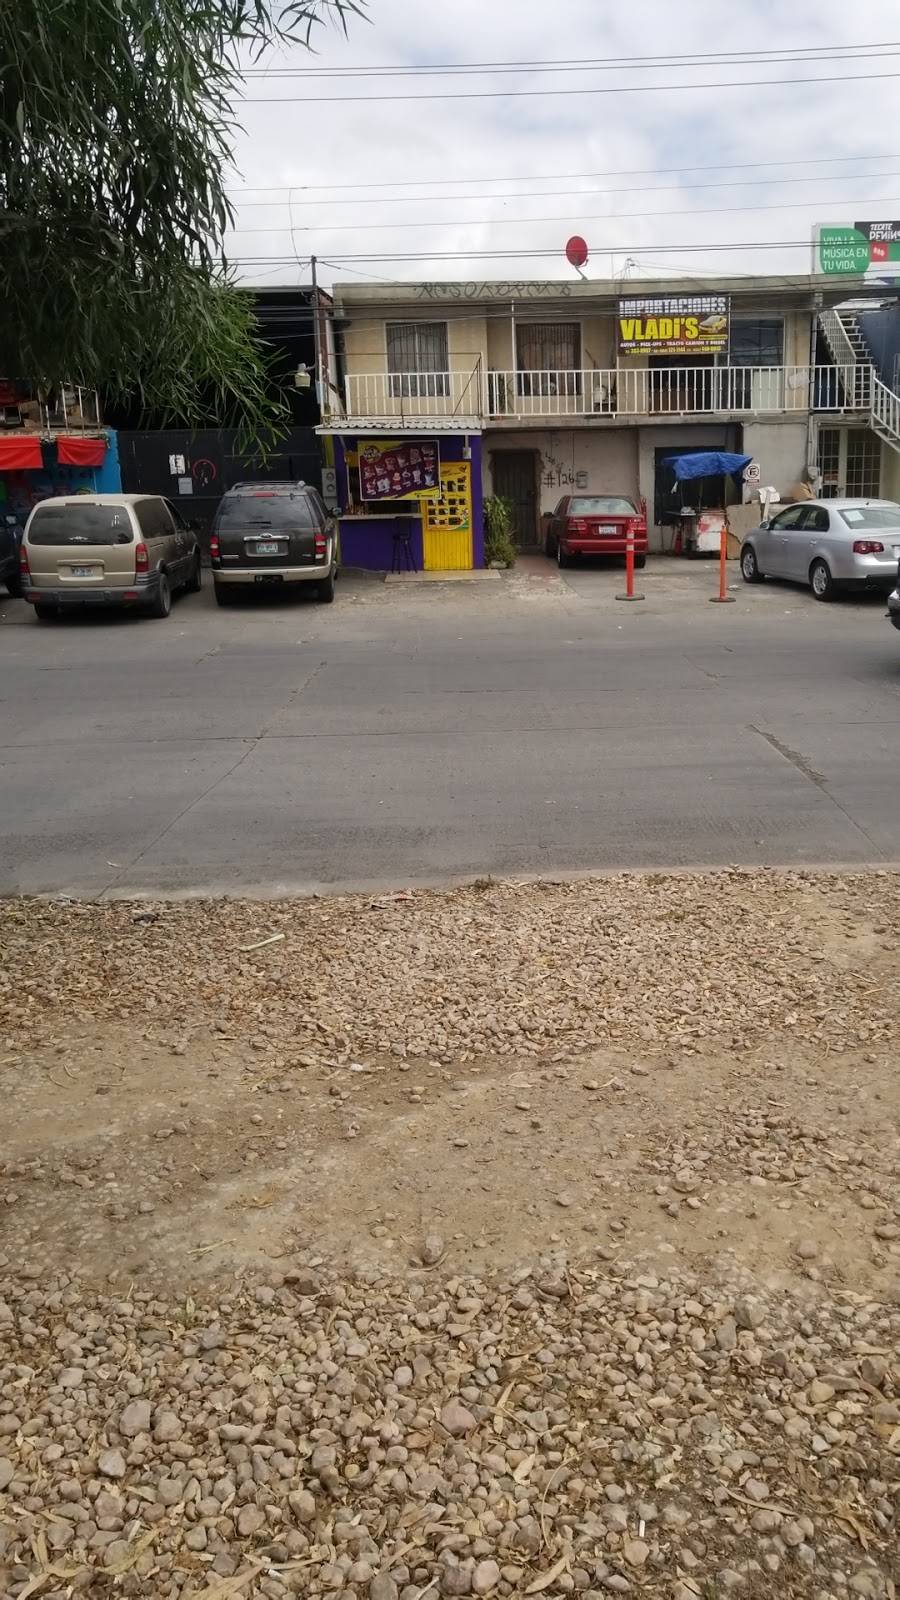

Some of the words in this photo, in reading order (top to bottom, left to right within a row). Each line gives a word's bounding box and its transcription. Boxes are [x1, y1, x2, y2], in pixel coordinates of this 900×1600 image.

[870, 223, 893, 231] TECATE
[823, 236, 842, 245] VIVA
[844, 236, 856, 245] LA
[823, 246, 855, 258] MÚSICA
[856, 247, 868, 258] EN
[823, 260, 834, 270] TU
[835, 260, 857, 270] VIDA
[620, 297, 726, 316] IMPORTACIONES
